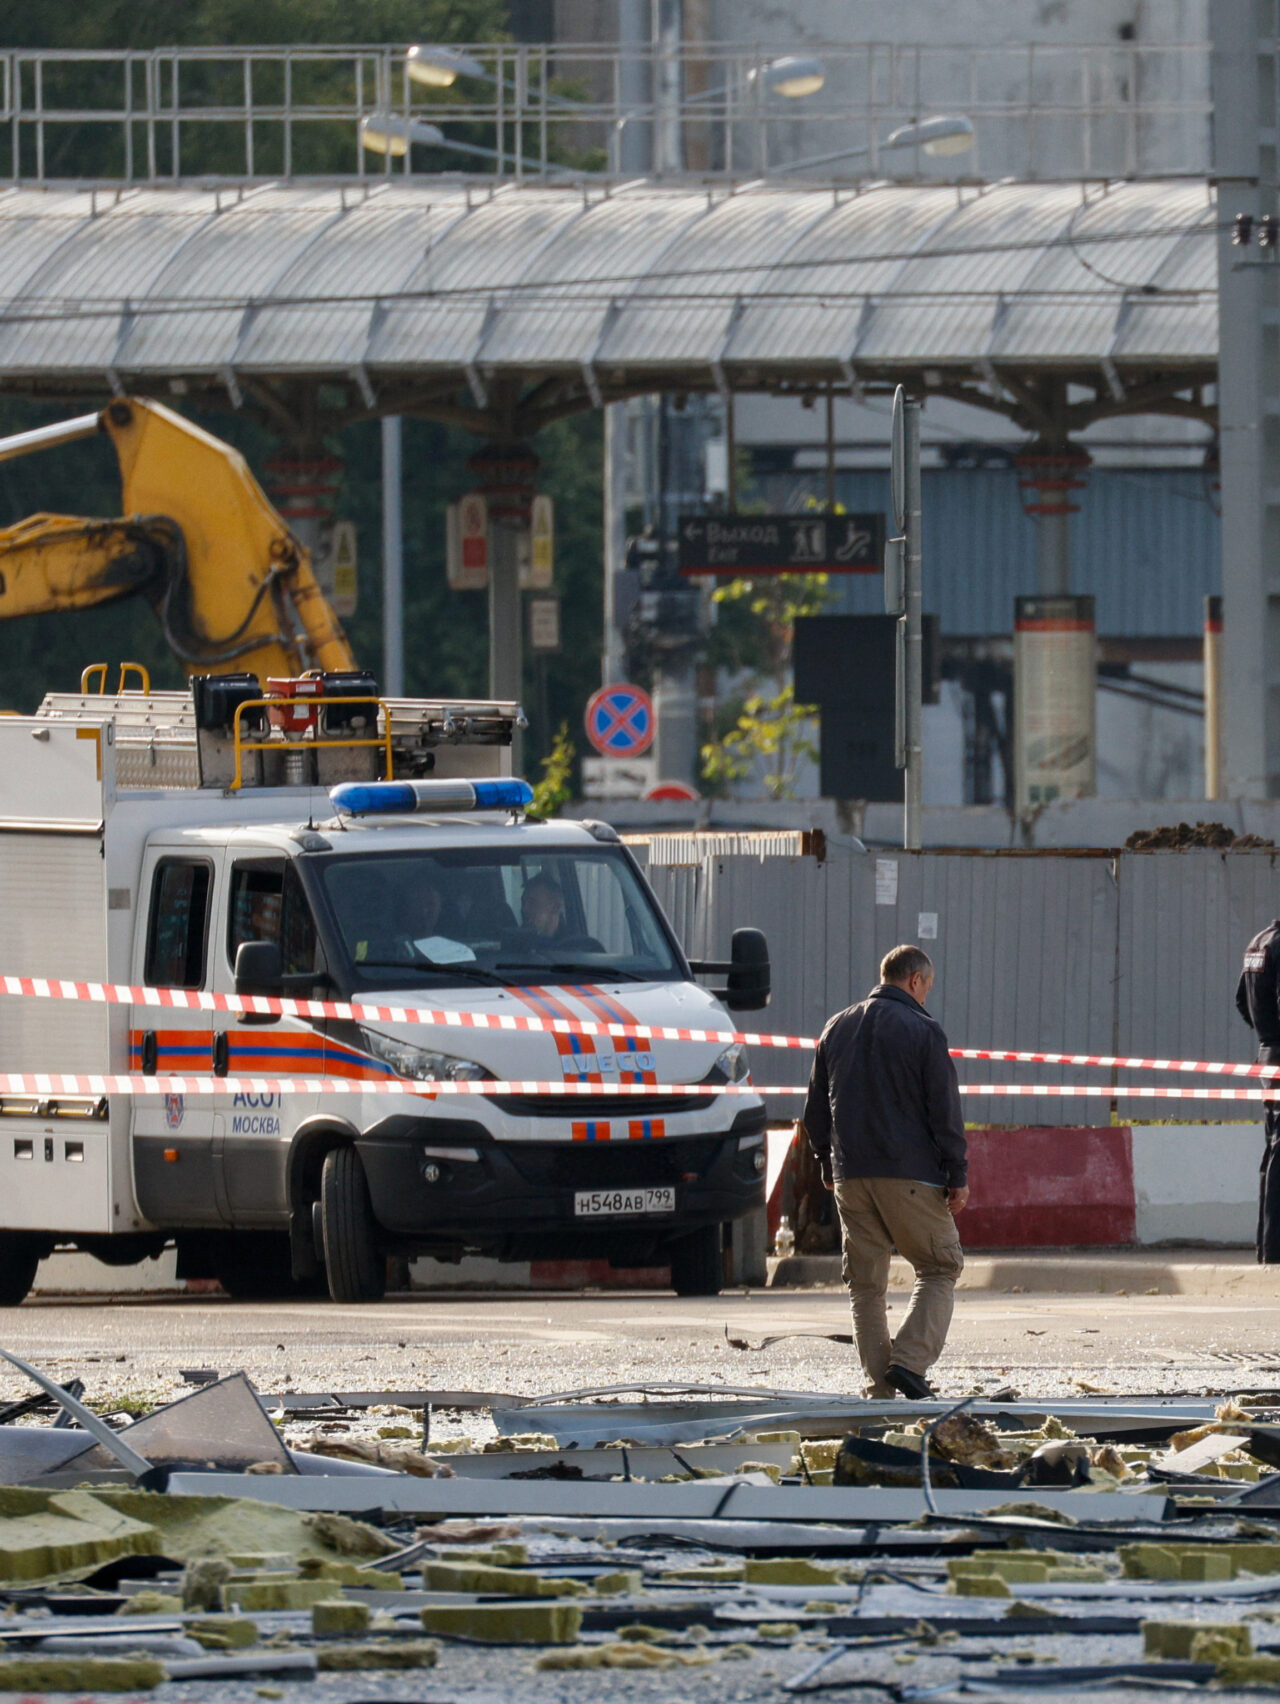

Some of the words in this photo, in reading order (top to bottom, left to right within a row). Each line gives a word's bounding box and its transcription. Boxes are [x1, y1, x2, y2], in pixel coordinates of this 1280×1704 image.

[706, 522, 780, 545] Выход
[561, 1052, 657, 1074] IVECO
[231, 1115, 281, 1135] МОСКВА
[646, 1189, 672, 1205] 799
